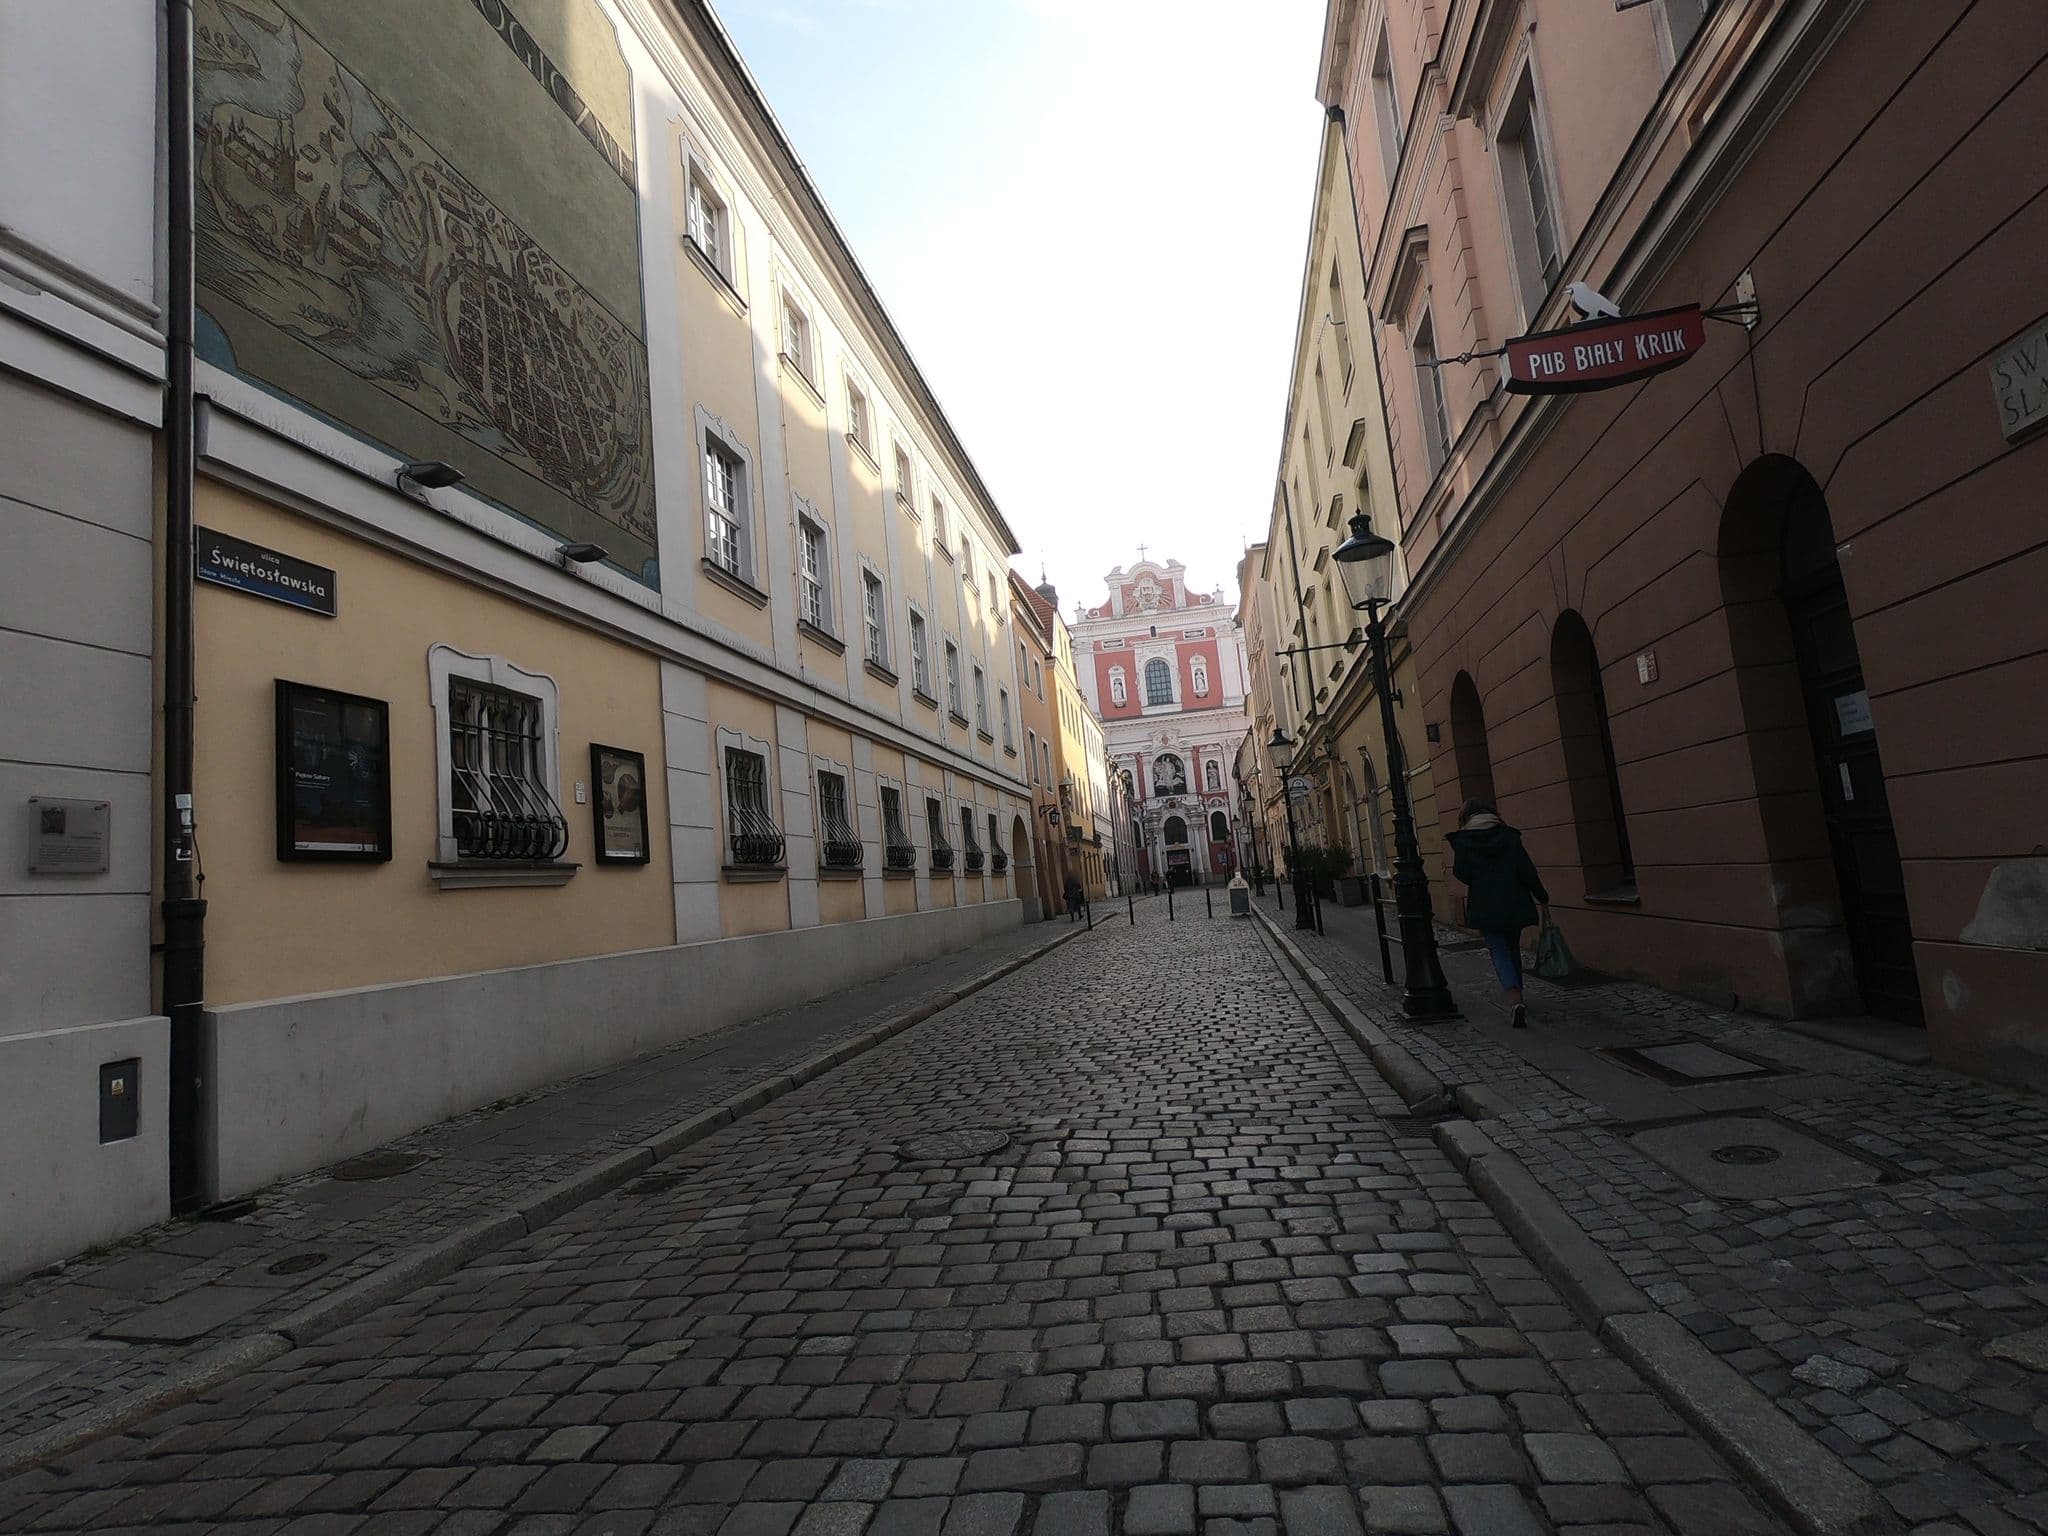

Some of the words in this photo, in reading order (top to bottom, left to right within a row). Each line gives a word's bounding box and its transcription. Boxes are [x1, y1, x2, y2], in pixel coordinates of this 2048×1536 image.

[1528, 351, 1566, 379] PUB
[1574, 340, 1624, 371] BIAŁY
[1634, 329, 1687, 361] KRUK
[1994, 332, 2048, 390] SW
[211, 545, 325, 597] Świętosławska
[261, 553, 280, 565] ulica
